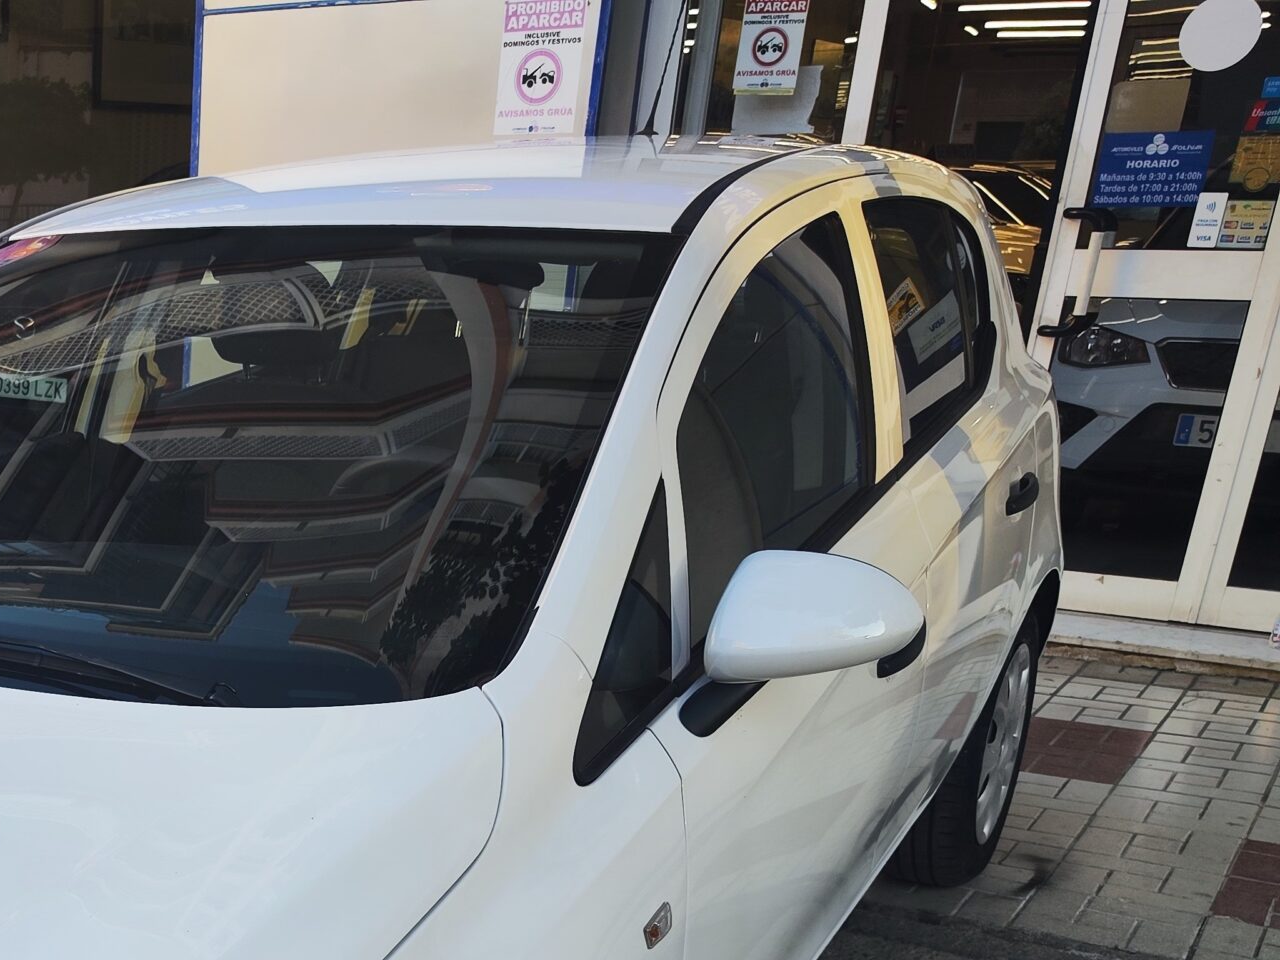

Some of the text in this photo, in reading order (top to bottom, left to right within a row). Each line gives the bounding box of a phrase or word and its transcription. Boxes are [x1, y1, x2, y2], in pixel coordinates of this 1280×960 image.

[508, 0, 584, 16] PROHIBIDO
[748, 1, 807, 12] APARCAR
[507, 12, 583, 30] APARCAR
[524, 31, 561, 39] INCLUSIVE
[503, 40, 539, 48] DOMINGOS
[547, 37, 582, 45] FESTIVOS
[498, 107, 573, 118] AVISAMOS GRÚA
[1252, 108, 1280, 117] Union
[1126, 159, 1180, 169] HORARIO
[1100, 173, 1135, 182] Mañanas
[1137, 173, 1147, 181] de
[1149, 172, 1166, 181] 9:30
[1176, 171, 1202, 180] 14:00h
[1100, 184, 1125, 193] Tardes
[1128, 184, 1138, 192] de
[1141, 184, 1161, 192] 17:00
[1170, 183, 1198, 192] 21:00h
[1094, 195, 1127, 204] Sábados
[1129, 195, 1139, 203] de
[1142, 194, 1163, 203] 10:00
[34, 379, 63, 399] LZK
